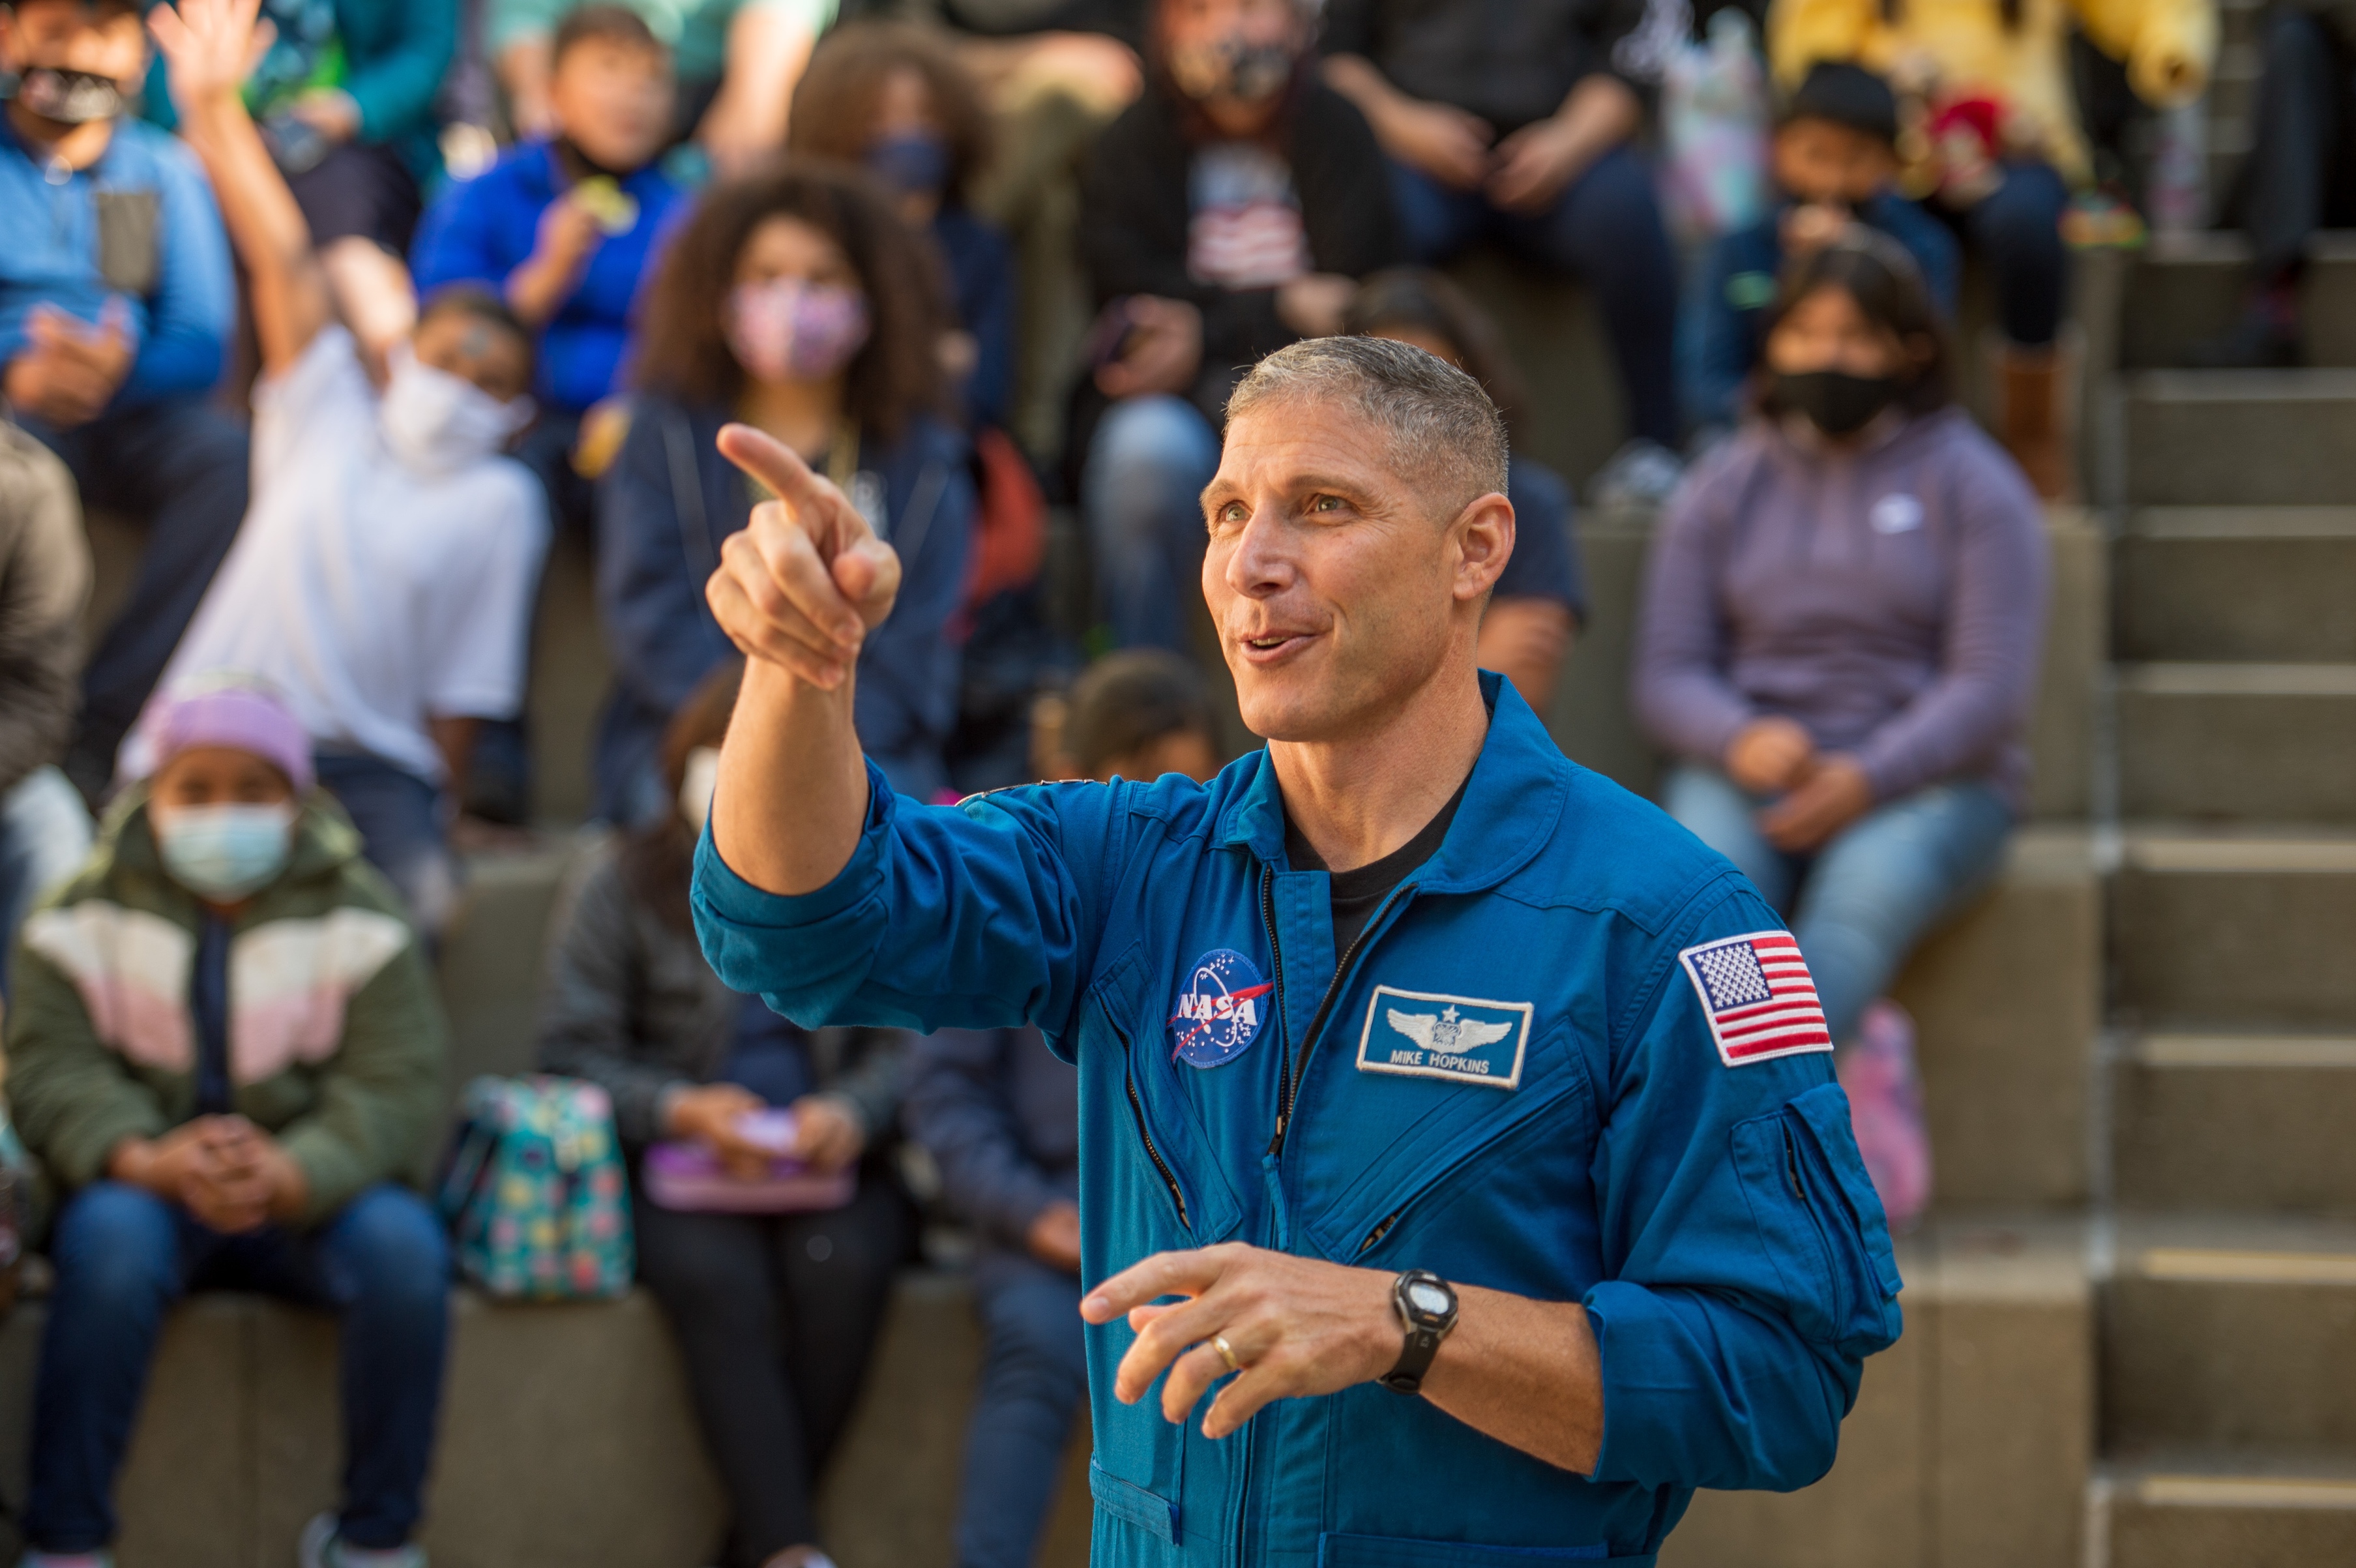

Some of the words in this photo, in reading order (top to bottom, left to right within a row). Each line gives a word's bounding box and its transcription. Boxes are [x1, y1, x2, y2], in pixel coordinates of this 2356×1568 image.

[1177, 994, 1258, 1026] NASA
[1390, 1050, 1423, 1065] MIKE
[1429, 1053, 1490, 1074] HOPKINS
